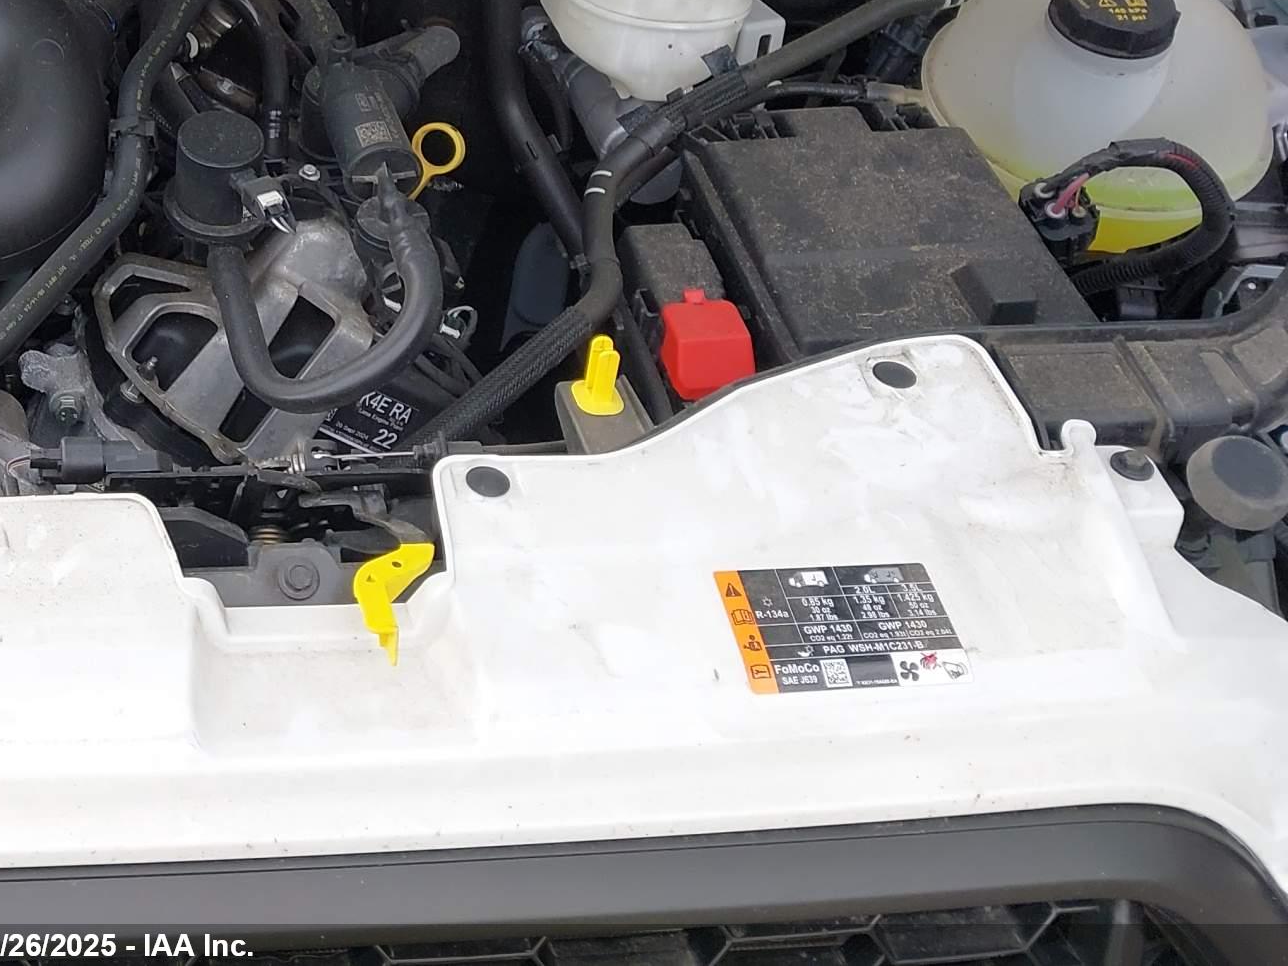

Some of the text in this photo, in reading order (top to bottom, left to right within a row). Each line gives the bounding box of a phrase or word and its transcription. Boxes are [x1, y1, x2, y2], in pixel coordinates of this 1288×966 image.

[389, 402, 412, 424] RA
[373, 428, 398, 450] 22
[854, 586, 876, 594] 2.0L
[821, 596, 834, 608] kg
[853, 594, 885, 605] 1.35 kg
[897, 592, 934, 602] 1.425 kg
[755, 610, 790, 618] R-134a
[803, 623, 853, 634] GWP 1430
[878, 620, 927, 630] GWP 1430
[822, 640, 924, 654] PAG WSH-M1C231-B
[774, 663, 820, 674] FoMoCo
[782, 675, 818, 685] SAE J639
